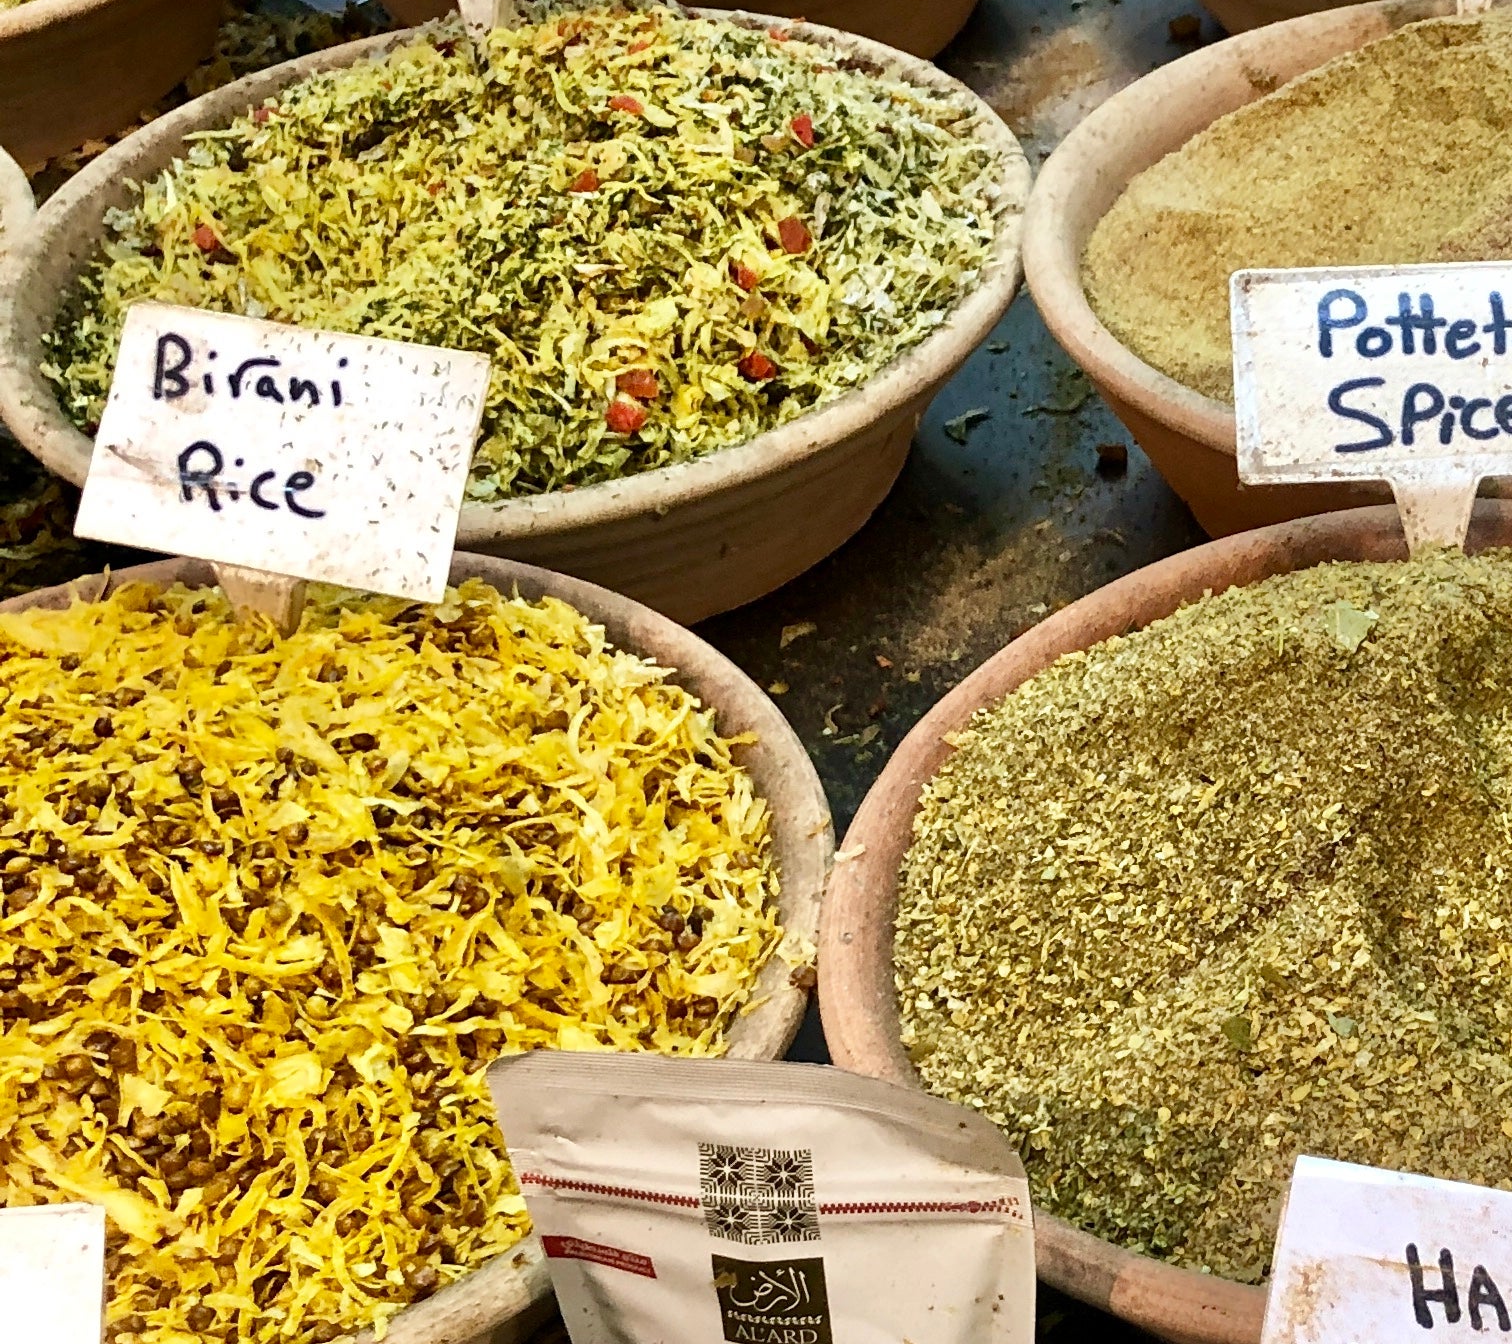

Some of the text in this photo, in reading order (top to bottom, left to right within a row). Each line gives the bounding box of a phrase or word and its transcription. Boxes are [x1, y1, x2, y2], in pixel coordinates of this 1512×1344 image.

[153, 332, 348, 406] Birani
[178, 441, 325, 518] Rice
[735, 1324, 818, 1344] AL'ARD
